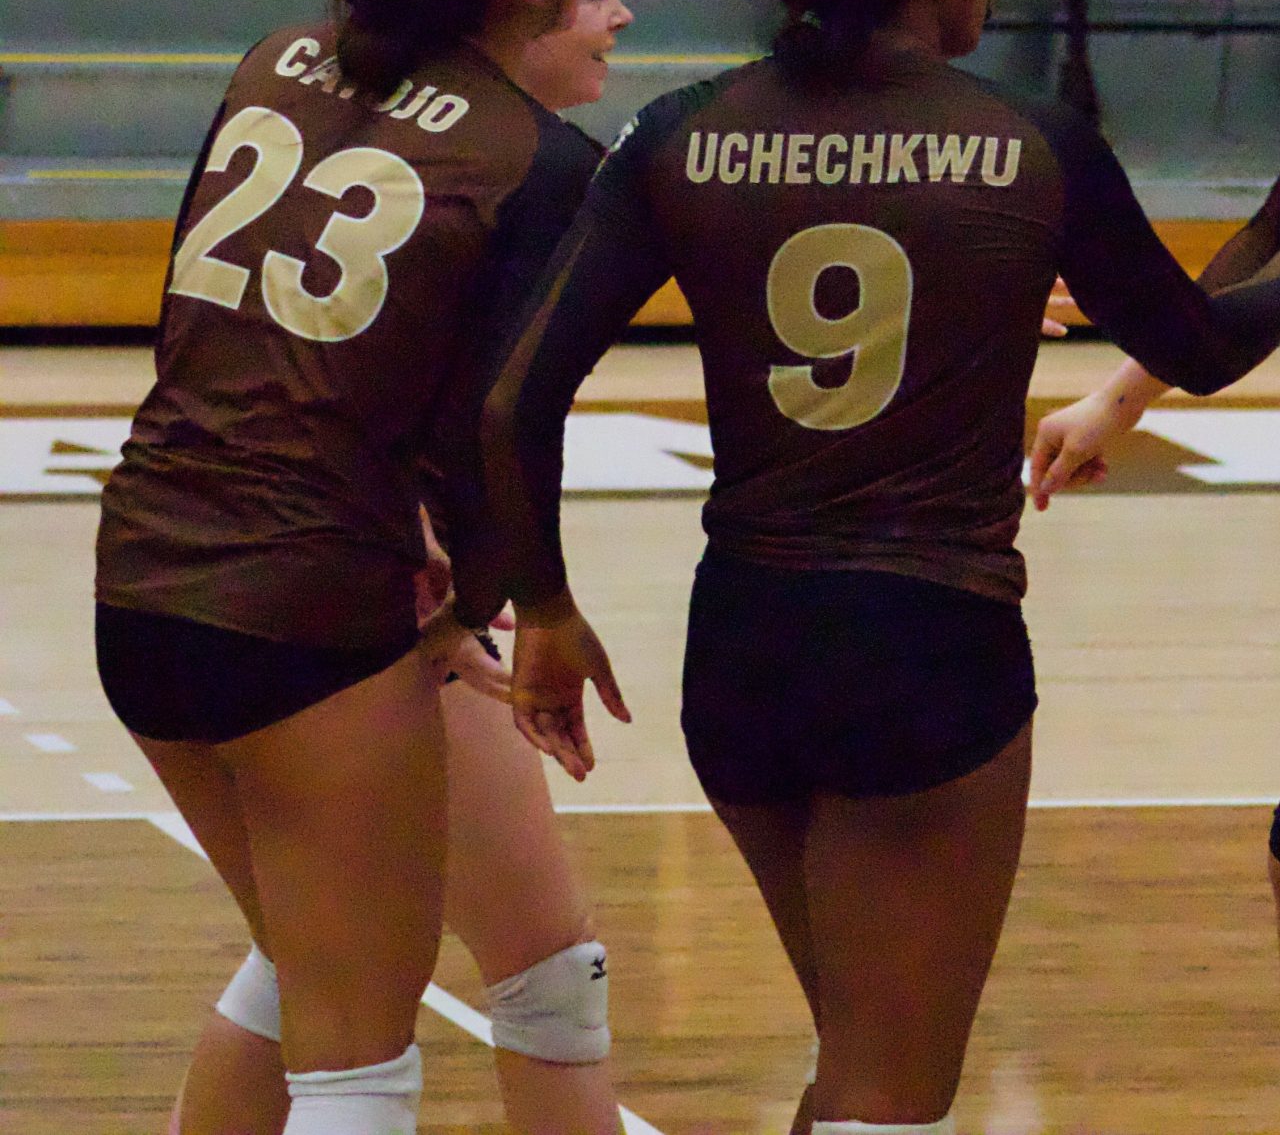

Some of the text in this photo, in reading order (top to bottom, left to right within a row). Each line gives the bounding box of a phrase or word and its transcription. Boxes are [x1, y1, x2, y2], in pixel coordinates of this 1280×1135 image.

[274, 37, 470, 133] CAJO
[686, 131, 1022, 187] UCHECHKWU
[168, 105, 425, 342] 23
[766, 223, 914, 430] 9
